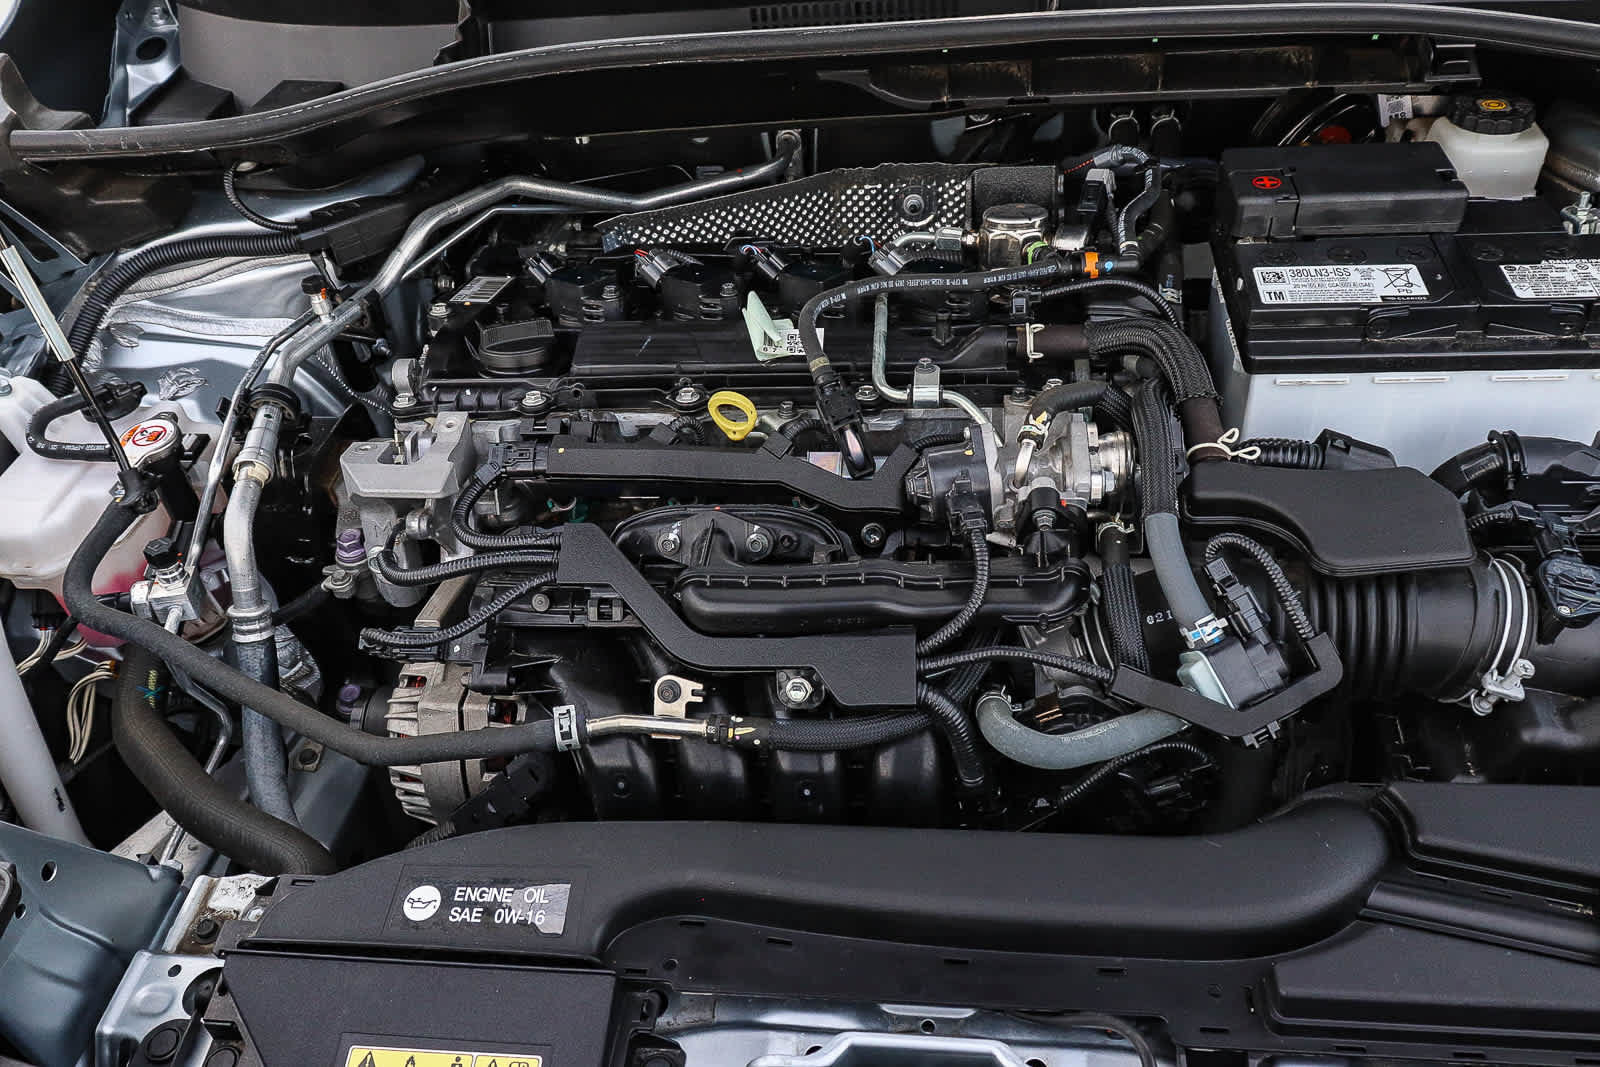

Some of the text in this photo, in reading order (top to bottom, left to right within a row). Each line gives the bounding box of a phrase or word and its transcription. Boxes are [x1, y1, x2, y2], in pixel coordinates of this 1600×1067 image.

[1288, 267, 1352, 278] 380LN3-ISS
[1266, 291, 1285, 301] TM
[1146, 610, 1173, 624] 021
[454, 887, 550, 904] ENGINE OIL
[449, 907, 546, 925] SAE 0W-16
